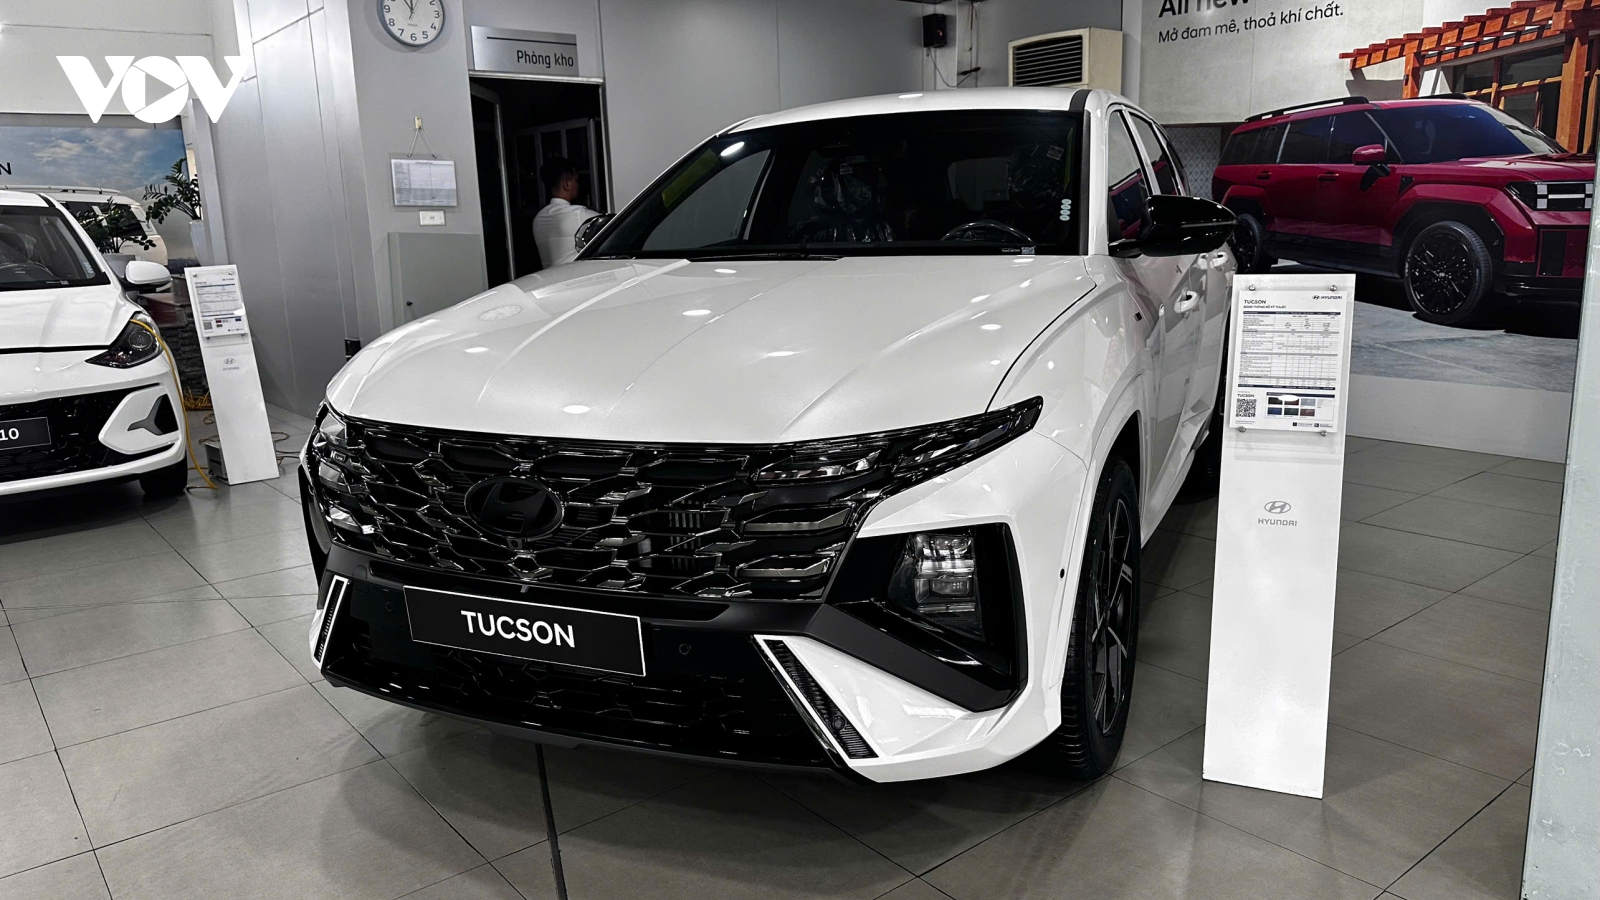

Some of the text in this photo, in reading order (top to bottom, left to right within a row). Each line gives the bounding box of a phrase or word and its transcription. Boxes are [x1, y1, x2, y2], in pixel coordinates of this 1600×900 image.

[383, 4, 391, 13] 9
[1158, 0, 1189, 18] All
[433, 10, 440, 19] 3
[388, 18, 396, 27] 8
[430, 22, 437, 31] 4
[1158, 1, 1344, 43] Mở đam mê, thoả khí chất.
[397, 28, 405, 37] 7
[410, 32, 417, 41] 6
[421, 31, 429, 39] 5
[516, 50, 574, 69] Phòng kho
[1257, 518, 1298, 527] HYUNDAI
[461, 610, 576, 649] TUCSON
